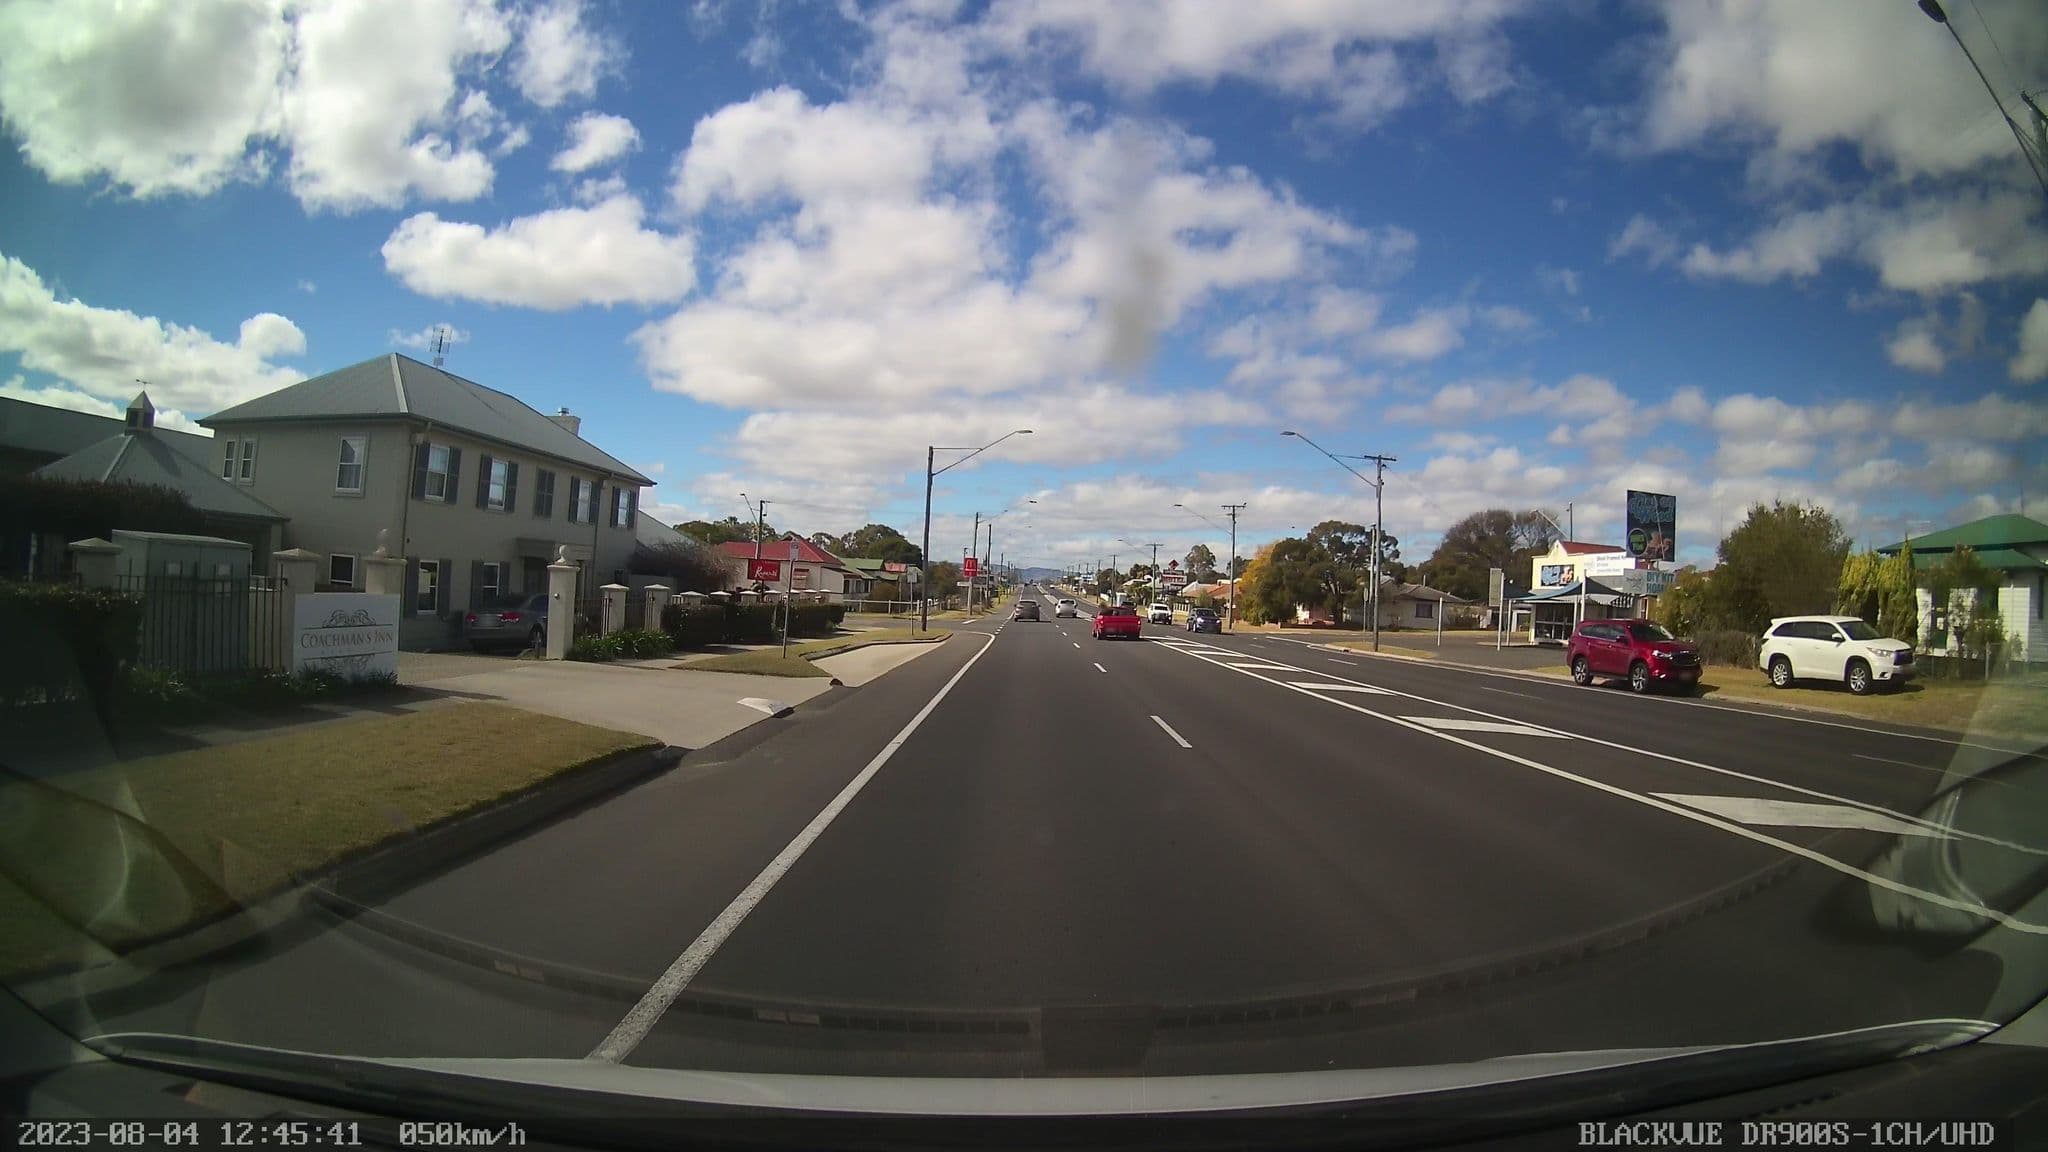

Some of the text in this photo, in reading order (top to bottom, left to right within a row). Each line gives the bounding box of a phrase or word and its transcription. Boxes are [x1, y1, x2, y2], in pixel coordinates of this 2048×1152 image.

[1647, 572, 1659, 582] DIY
[1647, 583, 1664, 593] HOM
[374, 631, 393, 645] INN
